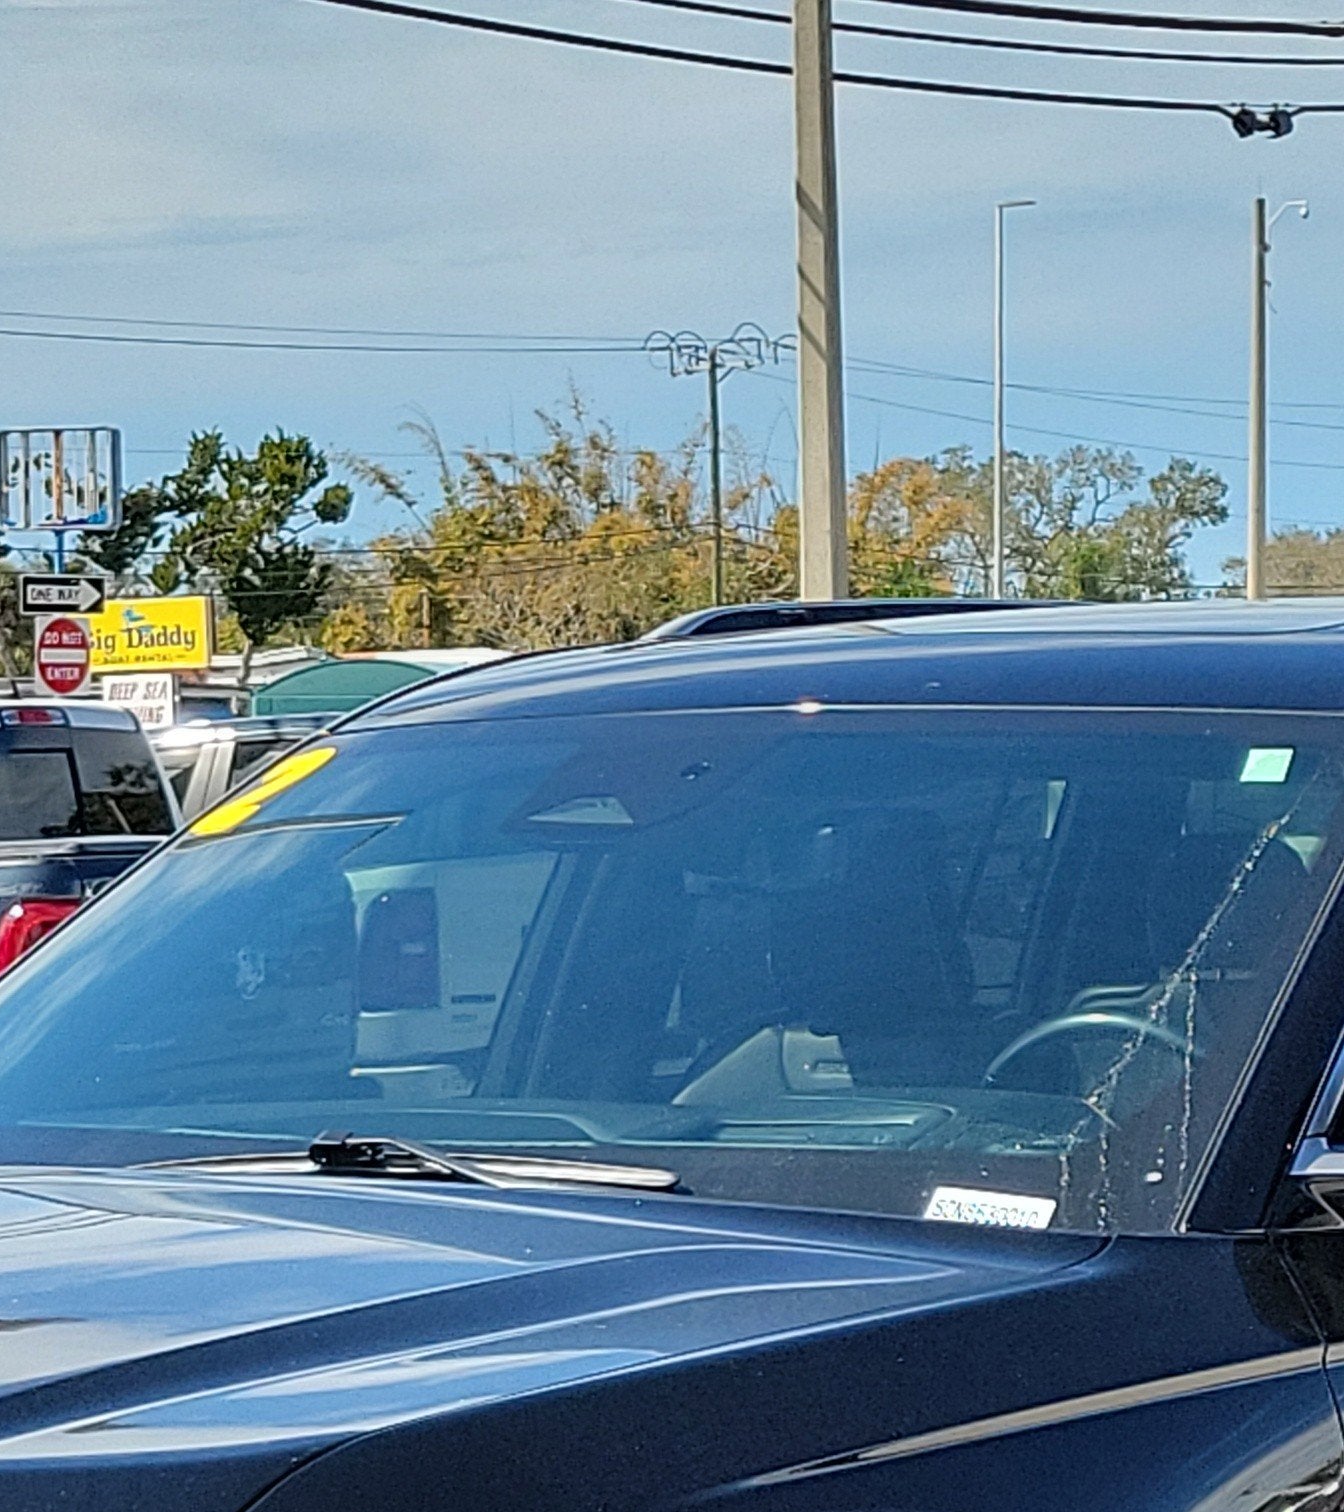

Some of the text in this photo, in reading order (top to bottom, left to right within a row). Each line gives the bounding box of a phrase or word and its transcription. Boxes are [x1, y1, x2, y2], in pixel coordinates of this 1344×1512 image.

[31, 587, 80, 602] ONE WAY
[43, 631, 82, 645] DO NOT
[126, 624, 196, 651] Daddy
[45, 666, 81, 681] ENTER
[143, 680, 167, 700] SEA
